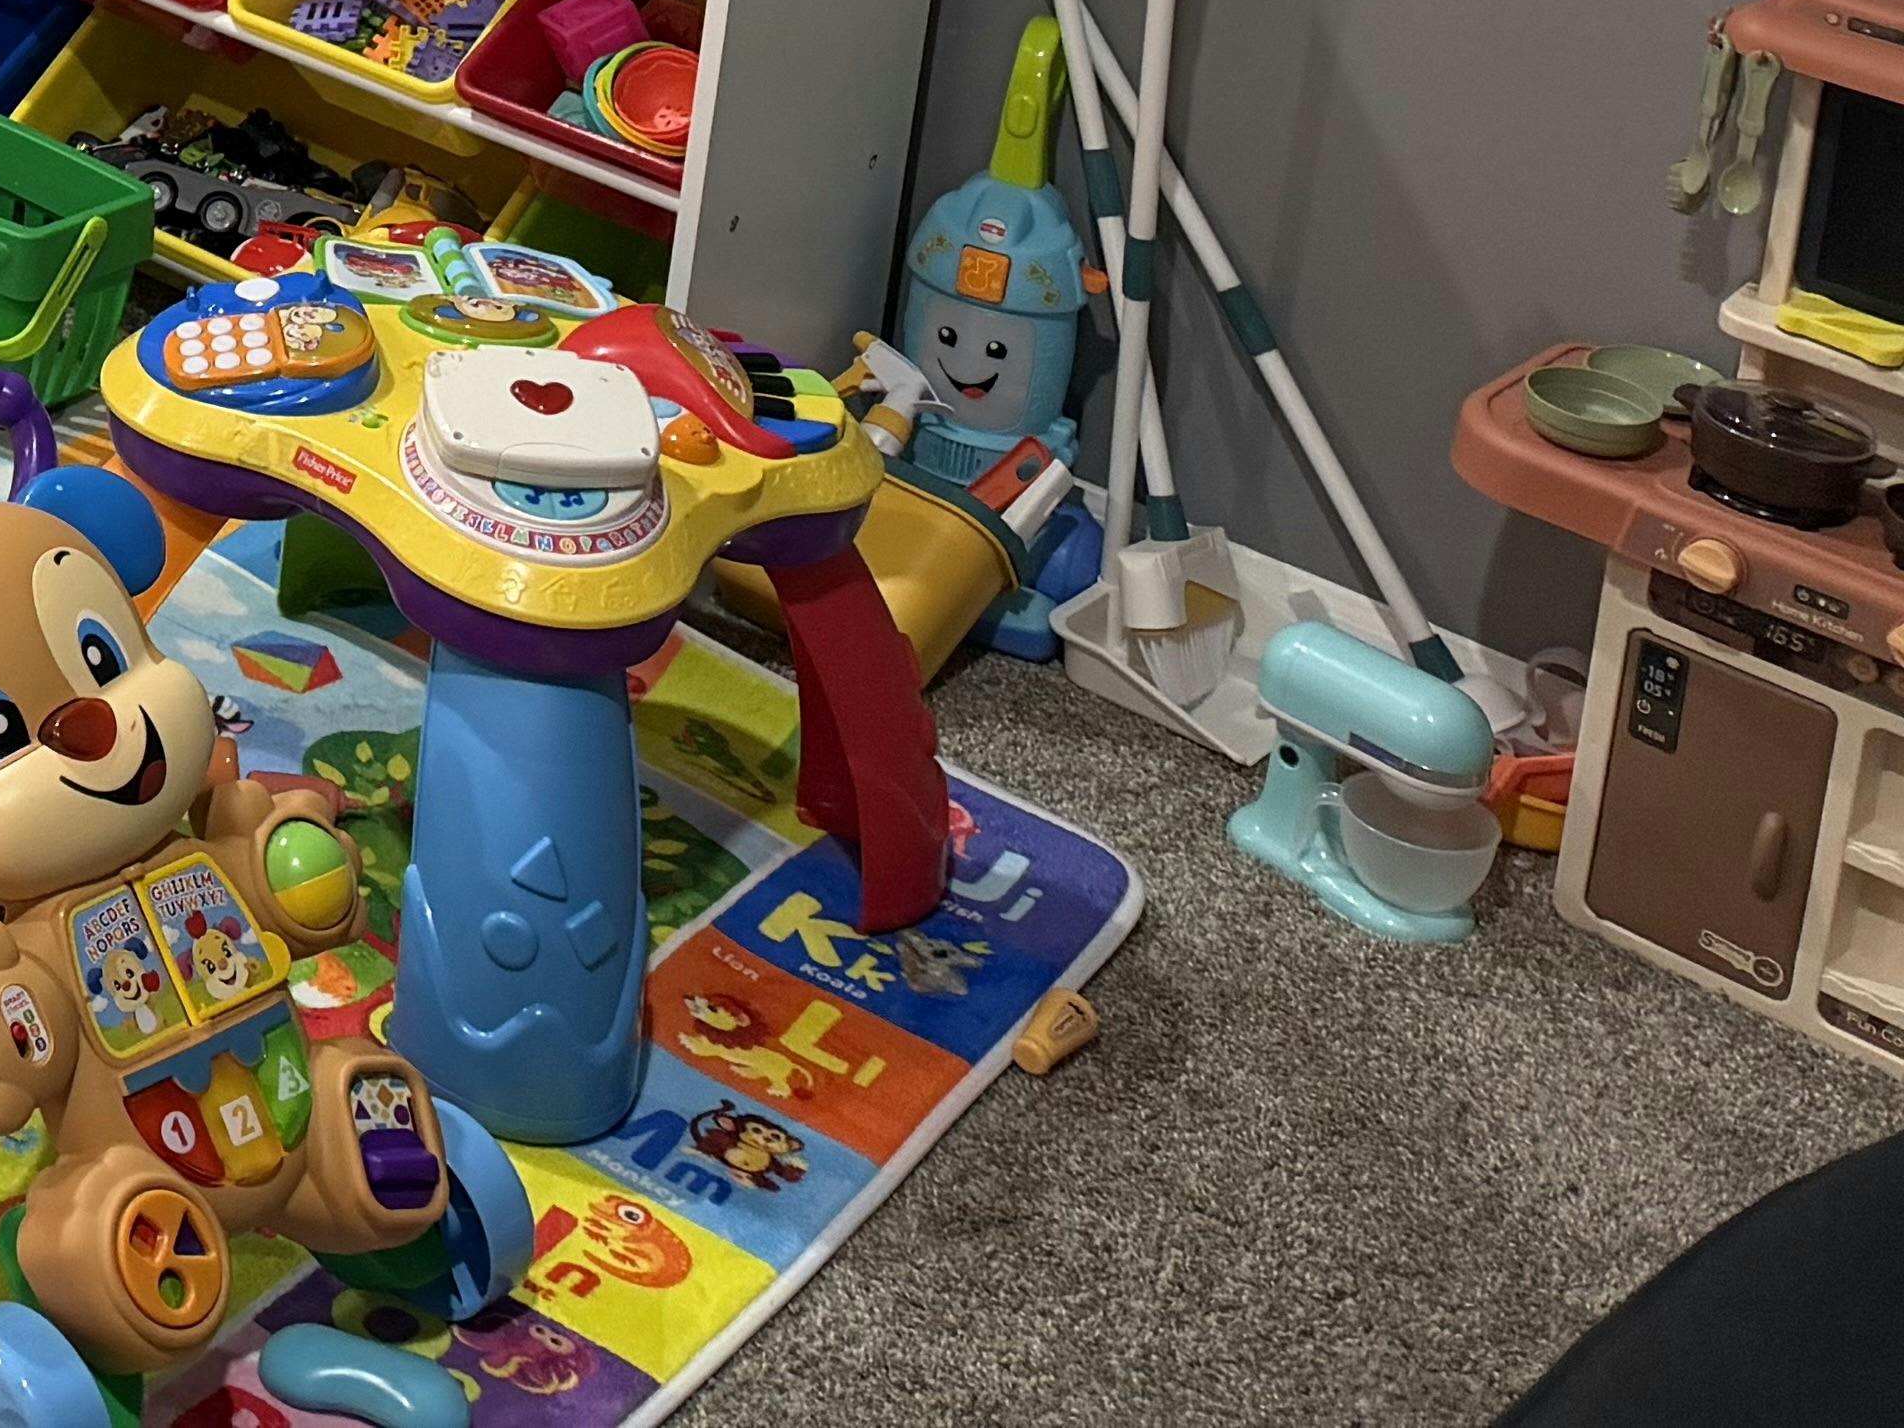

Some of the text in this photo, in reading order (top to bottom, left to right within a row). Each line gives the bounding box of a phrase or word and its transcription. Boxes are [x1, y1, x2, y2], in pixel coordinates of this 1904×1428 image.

[710, 945, 761, 983] Lion
[798, 961, 869, 1001] Koala
[232, 1104, 257, 1138] 2
